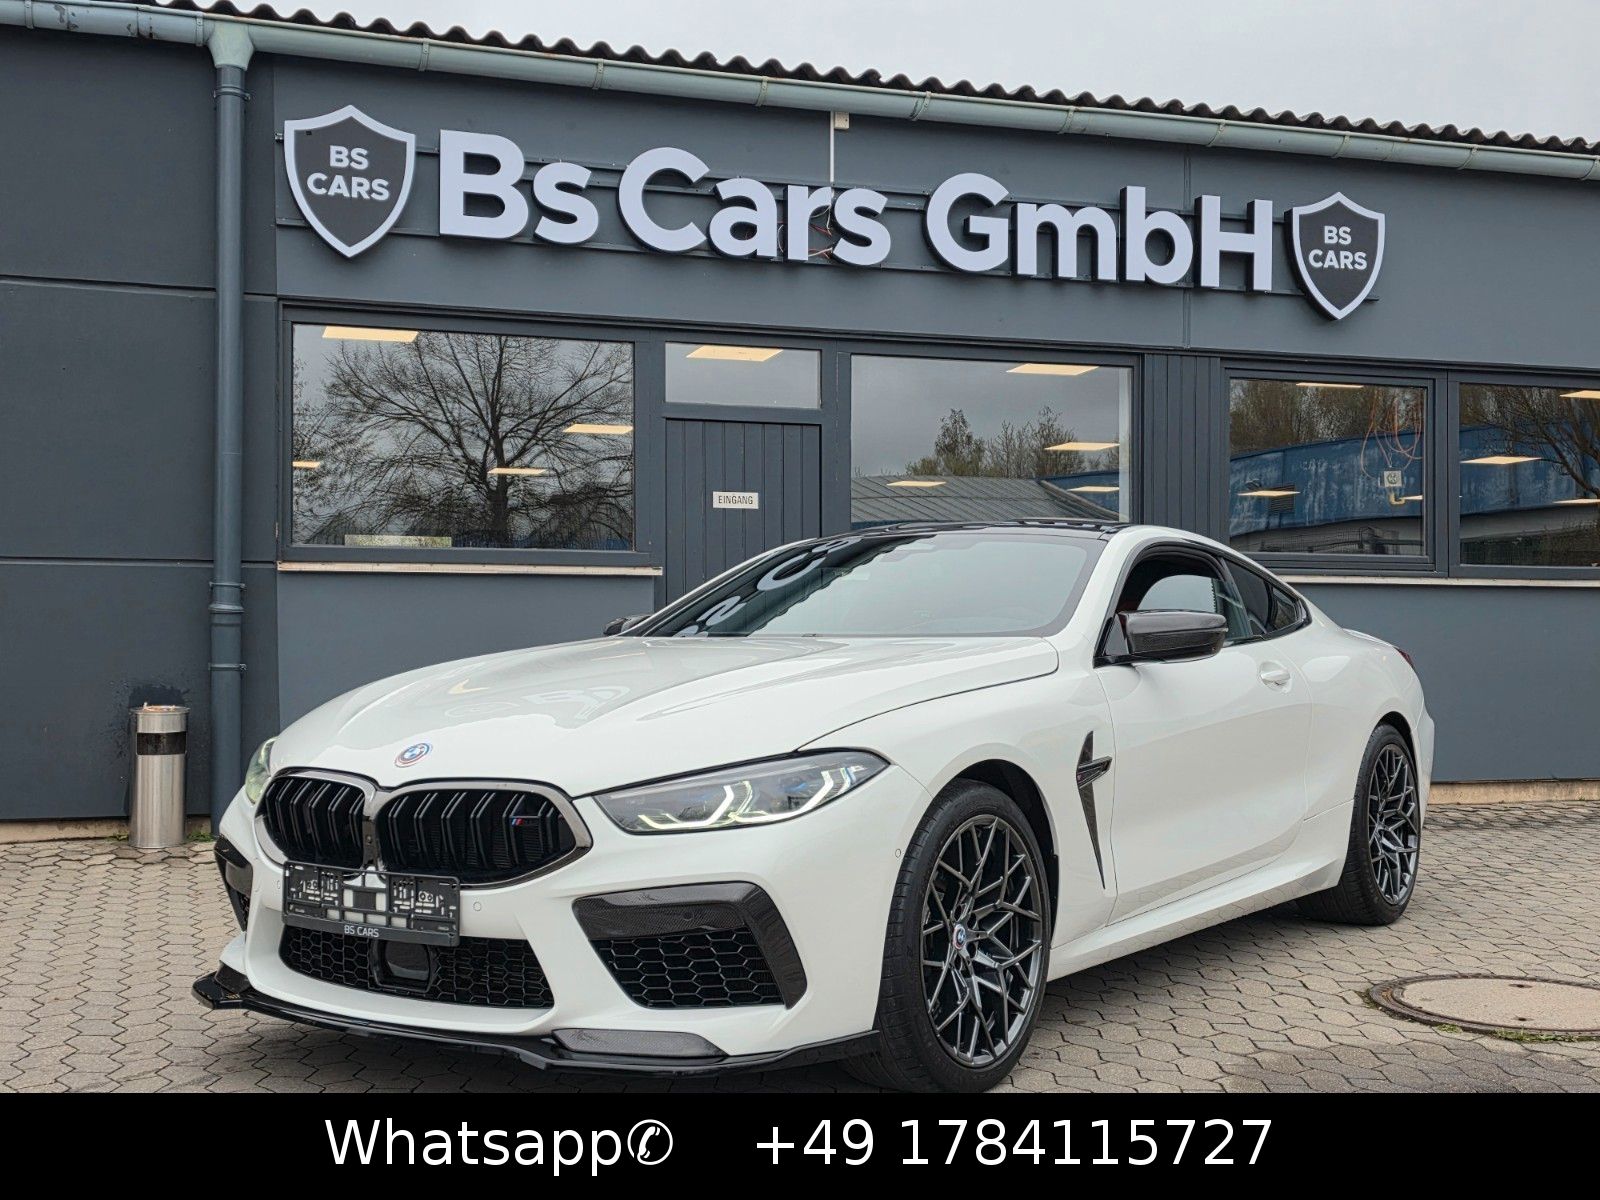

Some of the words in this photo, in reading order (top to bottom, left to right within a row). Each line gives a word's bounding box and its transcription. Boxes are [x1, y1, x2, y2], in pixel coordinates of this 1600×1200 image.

[330, 146, 369, 170] BS
[306, 172, 390, 201] CARS
[926, 172, 1273, 291] GmbH
[1324, 225, 1352, 245] BS
[1308, 249, 1368, 271] CARS
[718, 495, 754, 505] EINGANG
[344, 924, 356, 935] BS
[357, 926, 379, 938] CARS
